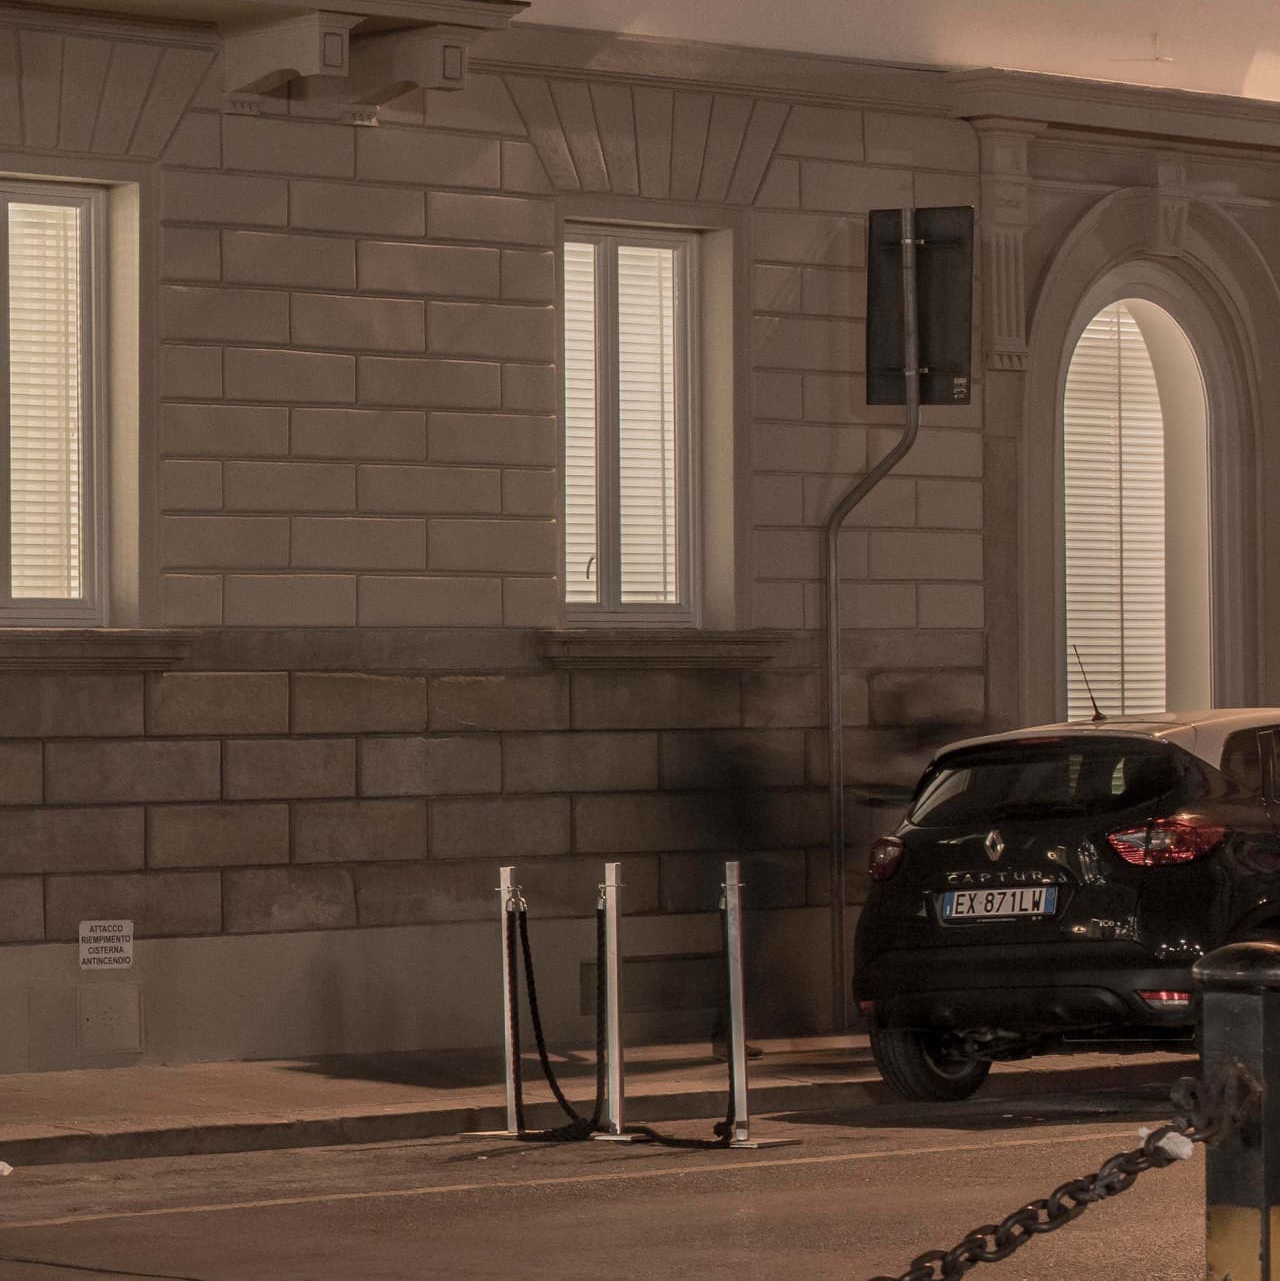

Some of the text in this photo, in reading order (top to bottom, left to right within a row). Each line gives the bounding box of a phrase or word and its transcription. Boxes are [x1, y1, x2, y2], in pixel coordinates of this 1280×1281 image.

[947, 871, 1042, 884] CAPTUR
[89, 925, 124, 933] ATTACCO
[81, 935, 131, 944] RIEMPIMENTO
[87, 946, 124, 955] CISTERNA
[81, 956, 131, 966] ANTINCENDIO
